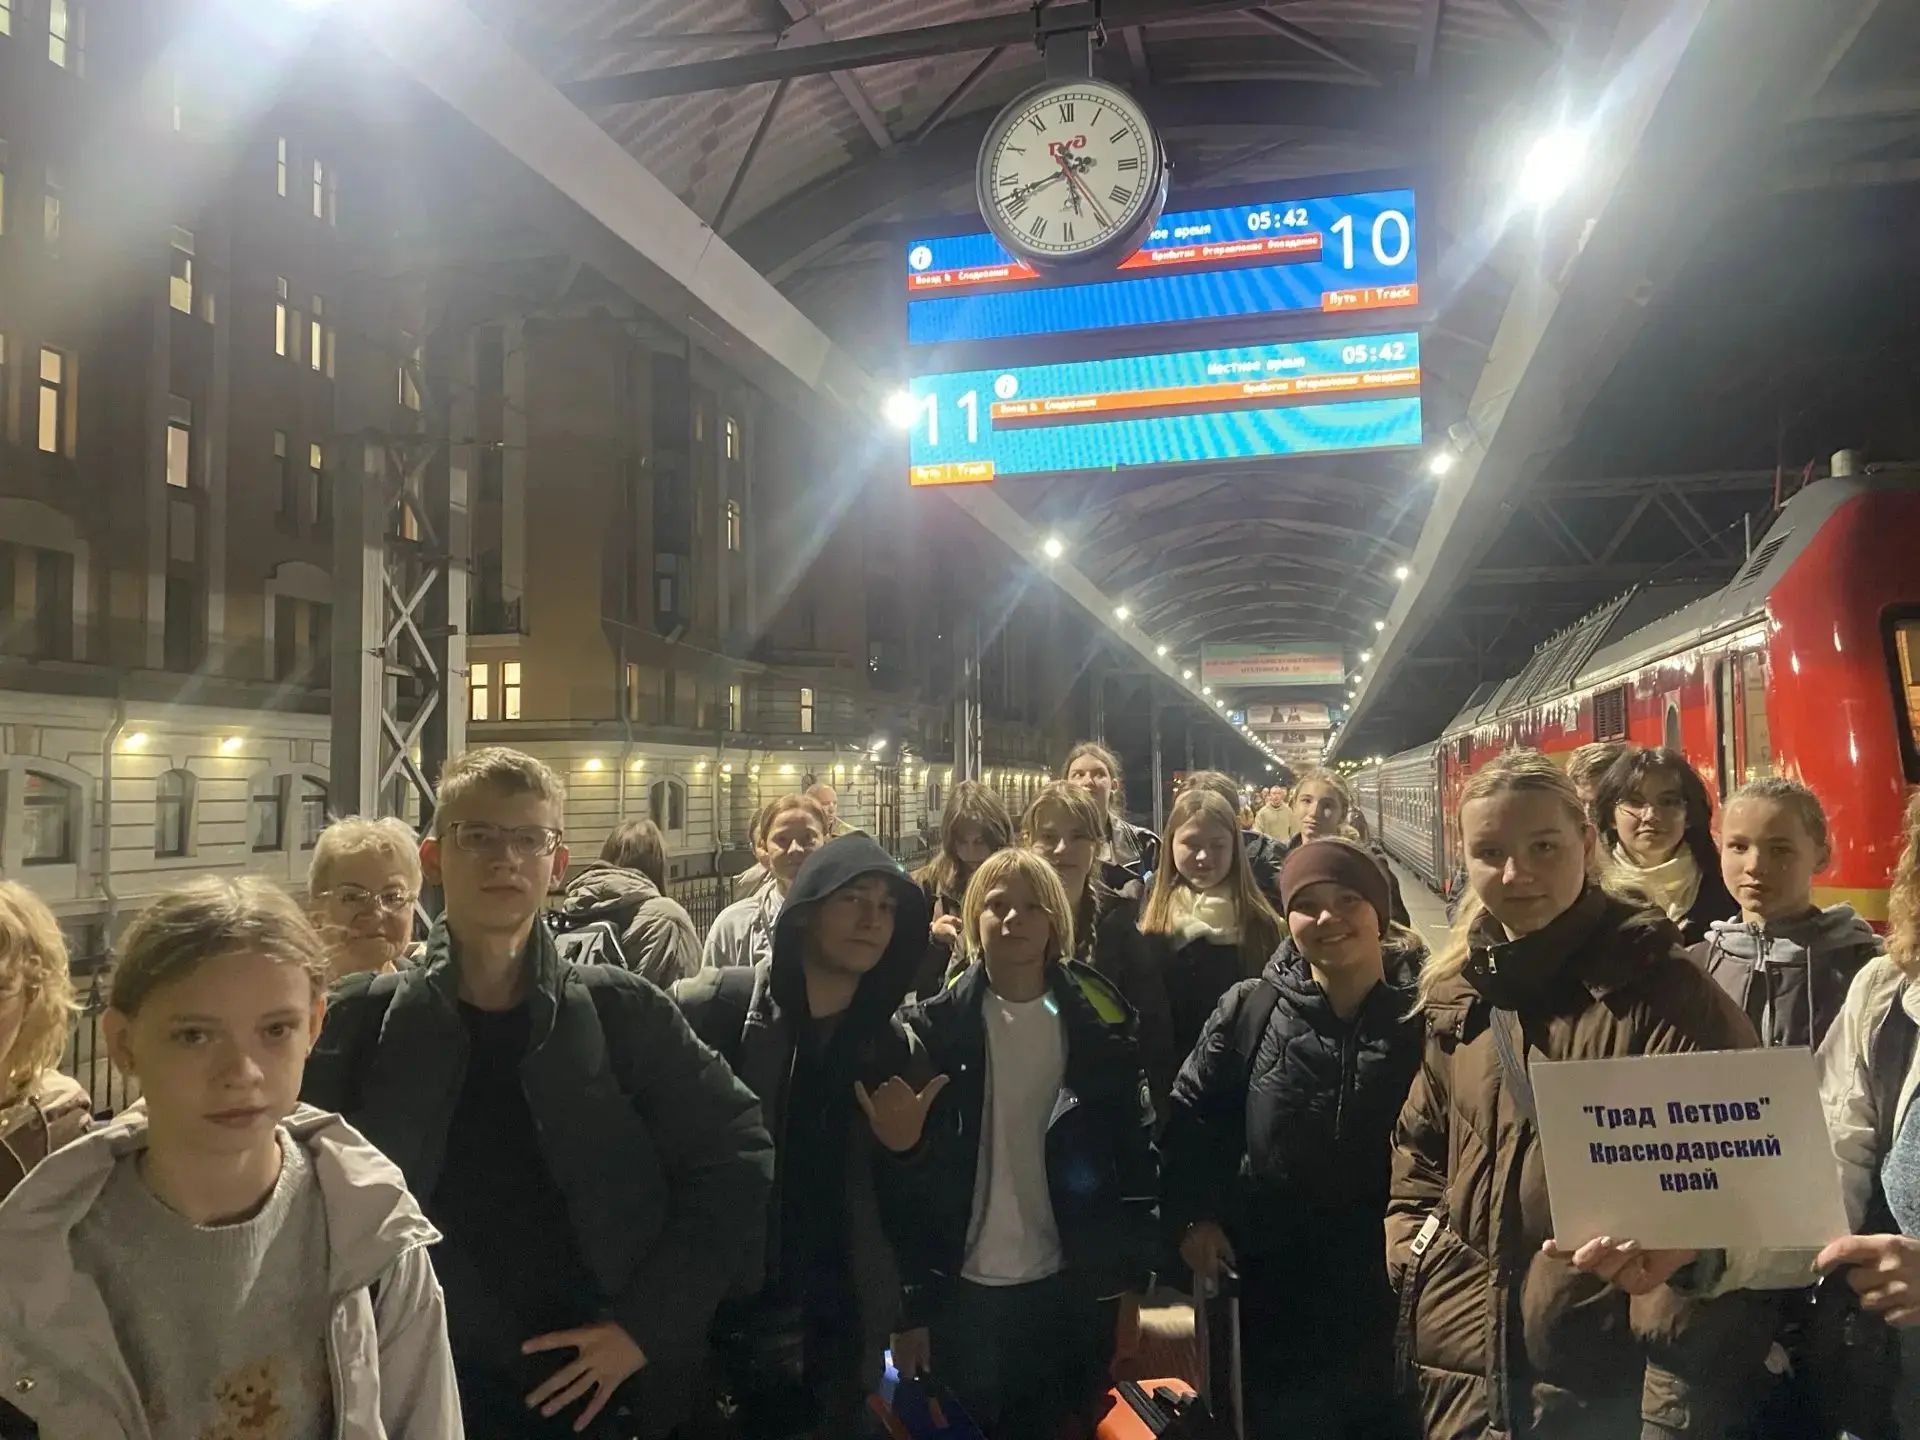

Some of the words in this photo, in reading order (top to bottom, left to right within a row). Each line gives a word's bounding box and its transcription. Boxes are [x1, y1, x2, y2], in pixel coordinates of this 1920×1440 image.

[1028, 113, 1047, 136] XI
[1059, 103, 1074, 124] XII
[1117, 157, 1139, 172] III
[1246, 208, 1309, 231] 05:42
[1329, 209, 1411, 271] 10
[1329, 291, 1357, 306] Путь
[1375, 287, 1411, 301] Track
[1342, 341, 1405, 365] 05:42
[918, 389, 977, 446] 11
[1583, 1105, 1656, 1129] "Град
[1668, 1097, 1771, 1125] Петров"
[1589, 1134, 1781, 1164] Краснодарский
[1660, 1168, 1719, 1193] край
